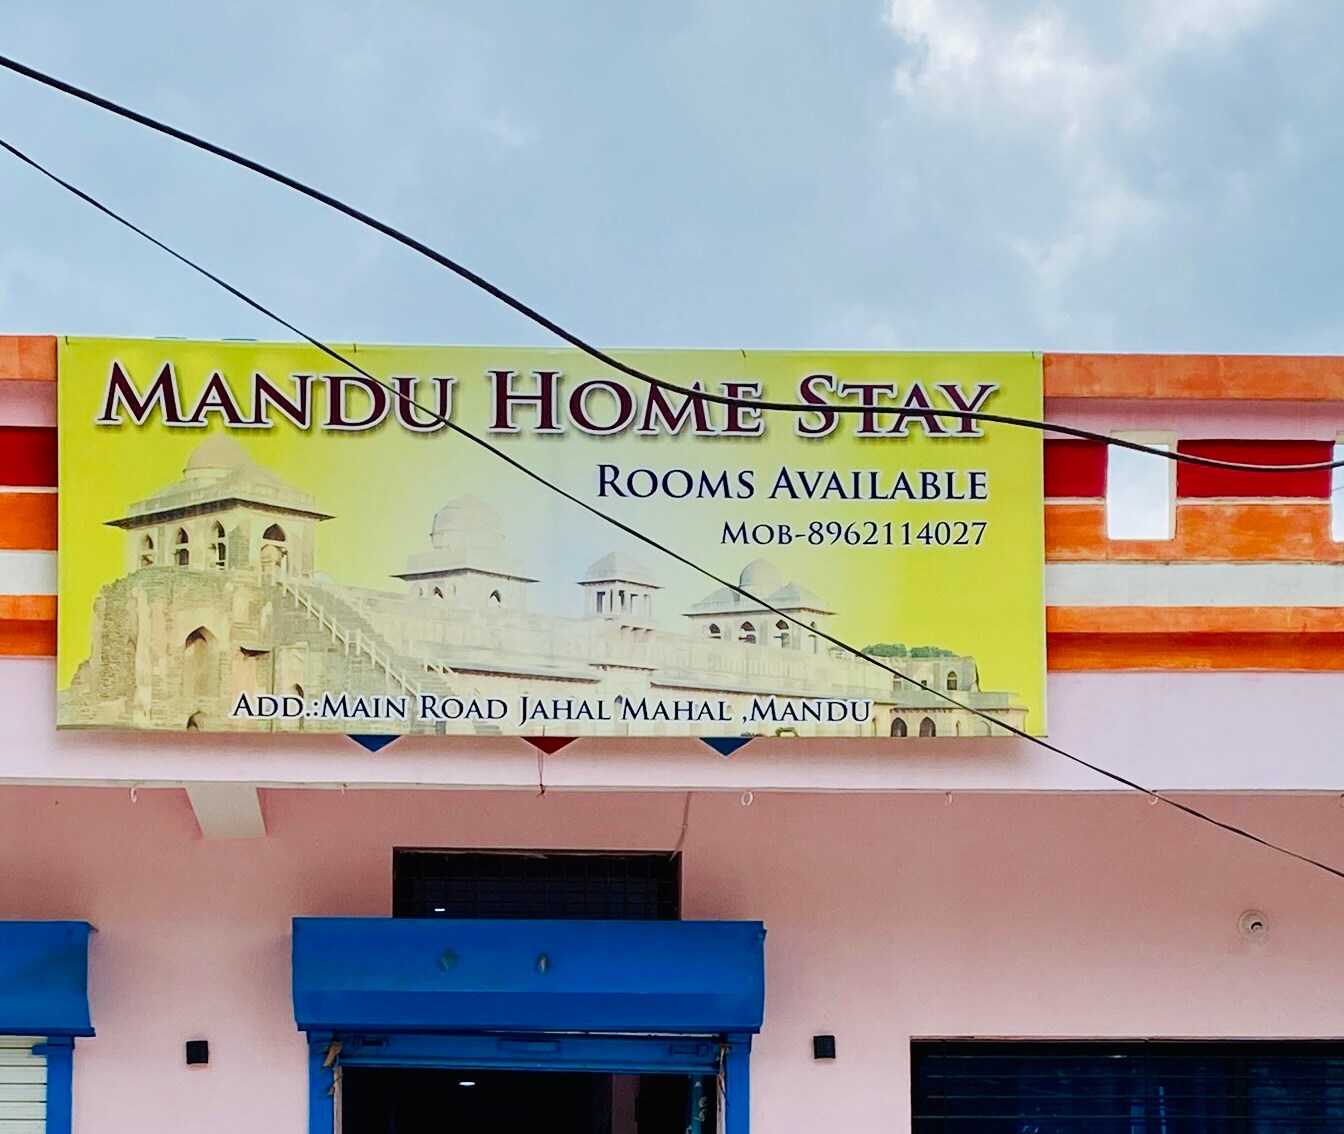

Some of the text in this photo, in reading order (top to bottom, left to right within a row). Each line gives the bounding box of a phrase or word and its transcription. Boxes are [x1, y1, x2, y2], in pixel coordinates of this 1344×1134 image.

[97, 361, 997, 438] MANDU HOME STAY
[596, 464, 988, 500] ROOMS AVAILABLE
[720, 520, 988, 545] MOB-8962114027
[232, 692, 406, 720] ADD.:MAIN
[420, 695, 508, 720] ROAD
[518, 695, 611, 727] JAHAL
[620, 697, 732, 722] MAHAL
